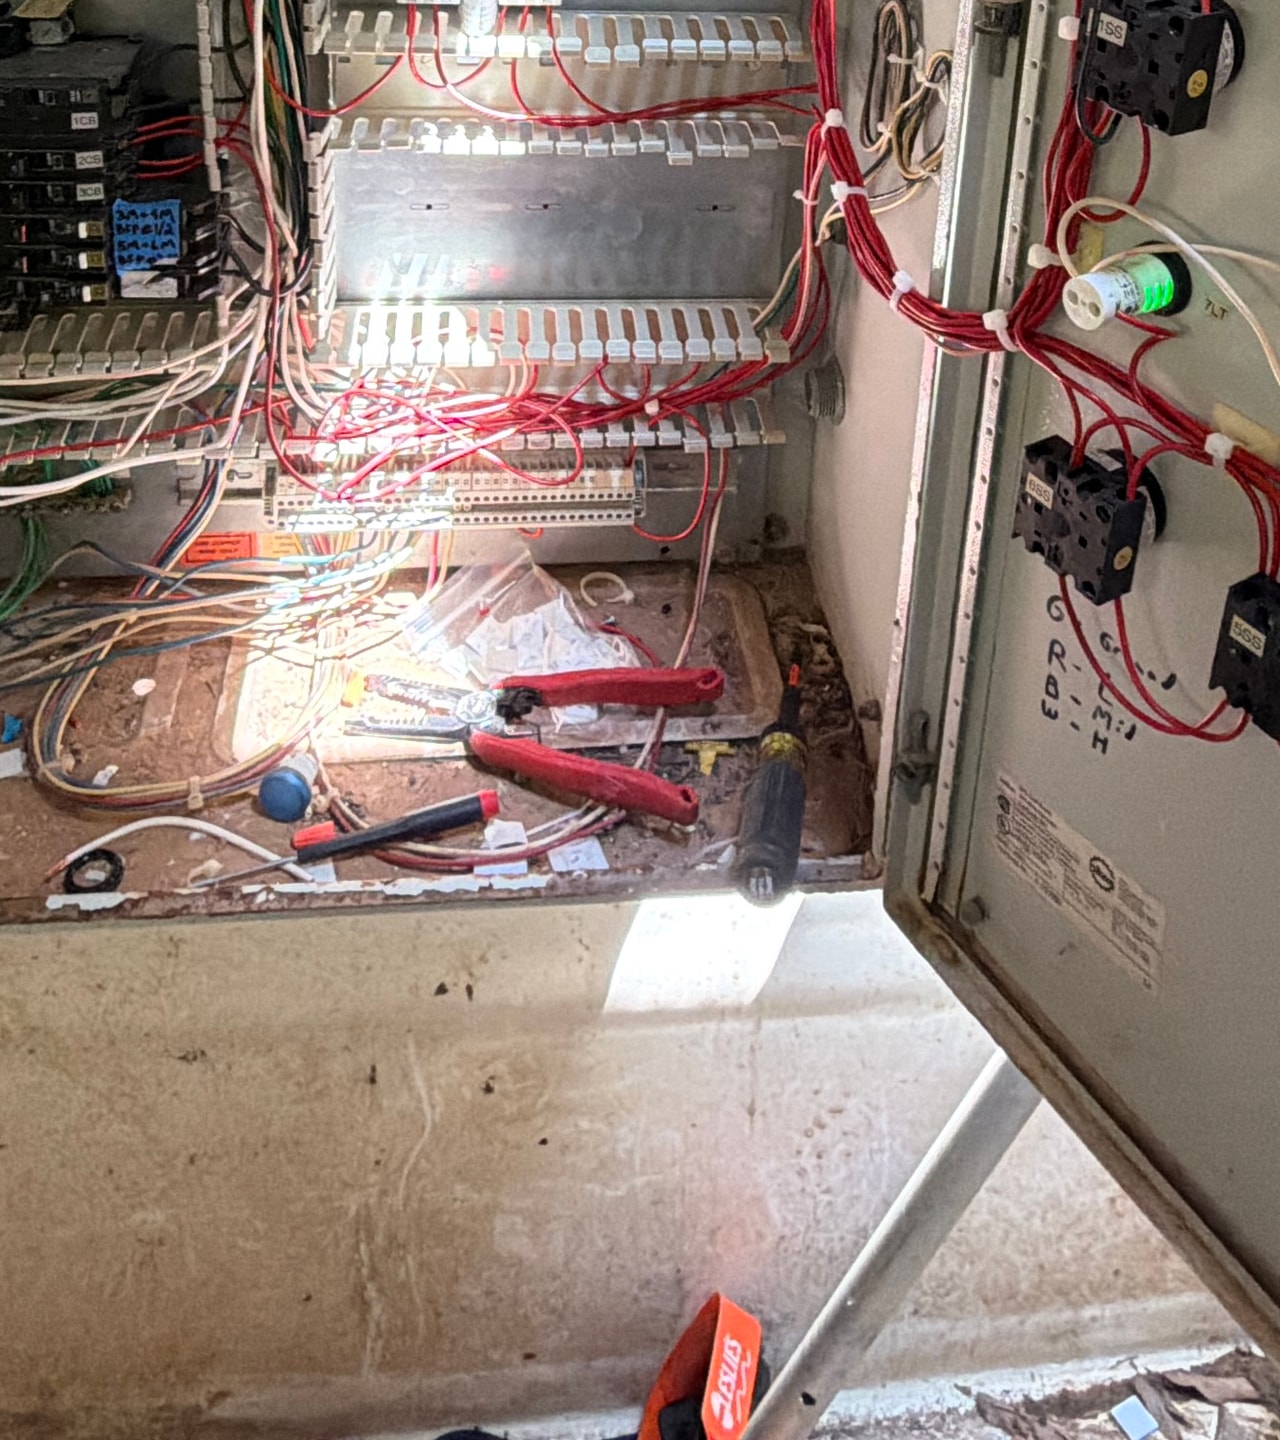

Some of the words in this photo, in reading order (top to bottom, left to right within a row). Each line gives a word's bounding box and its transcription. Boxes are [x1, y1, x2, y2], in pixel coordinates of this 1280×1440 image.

[72, 115, 98, 127] 1CB
[78, 186, 103, 198] 3CB
[1204, 299, 1229, 320] 7LT
[1048, 638, 1067, 673] R
